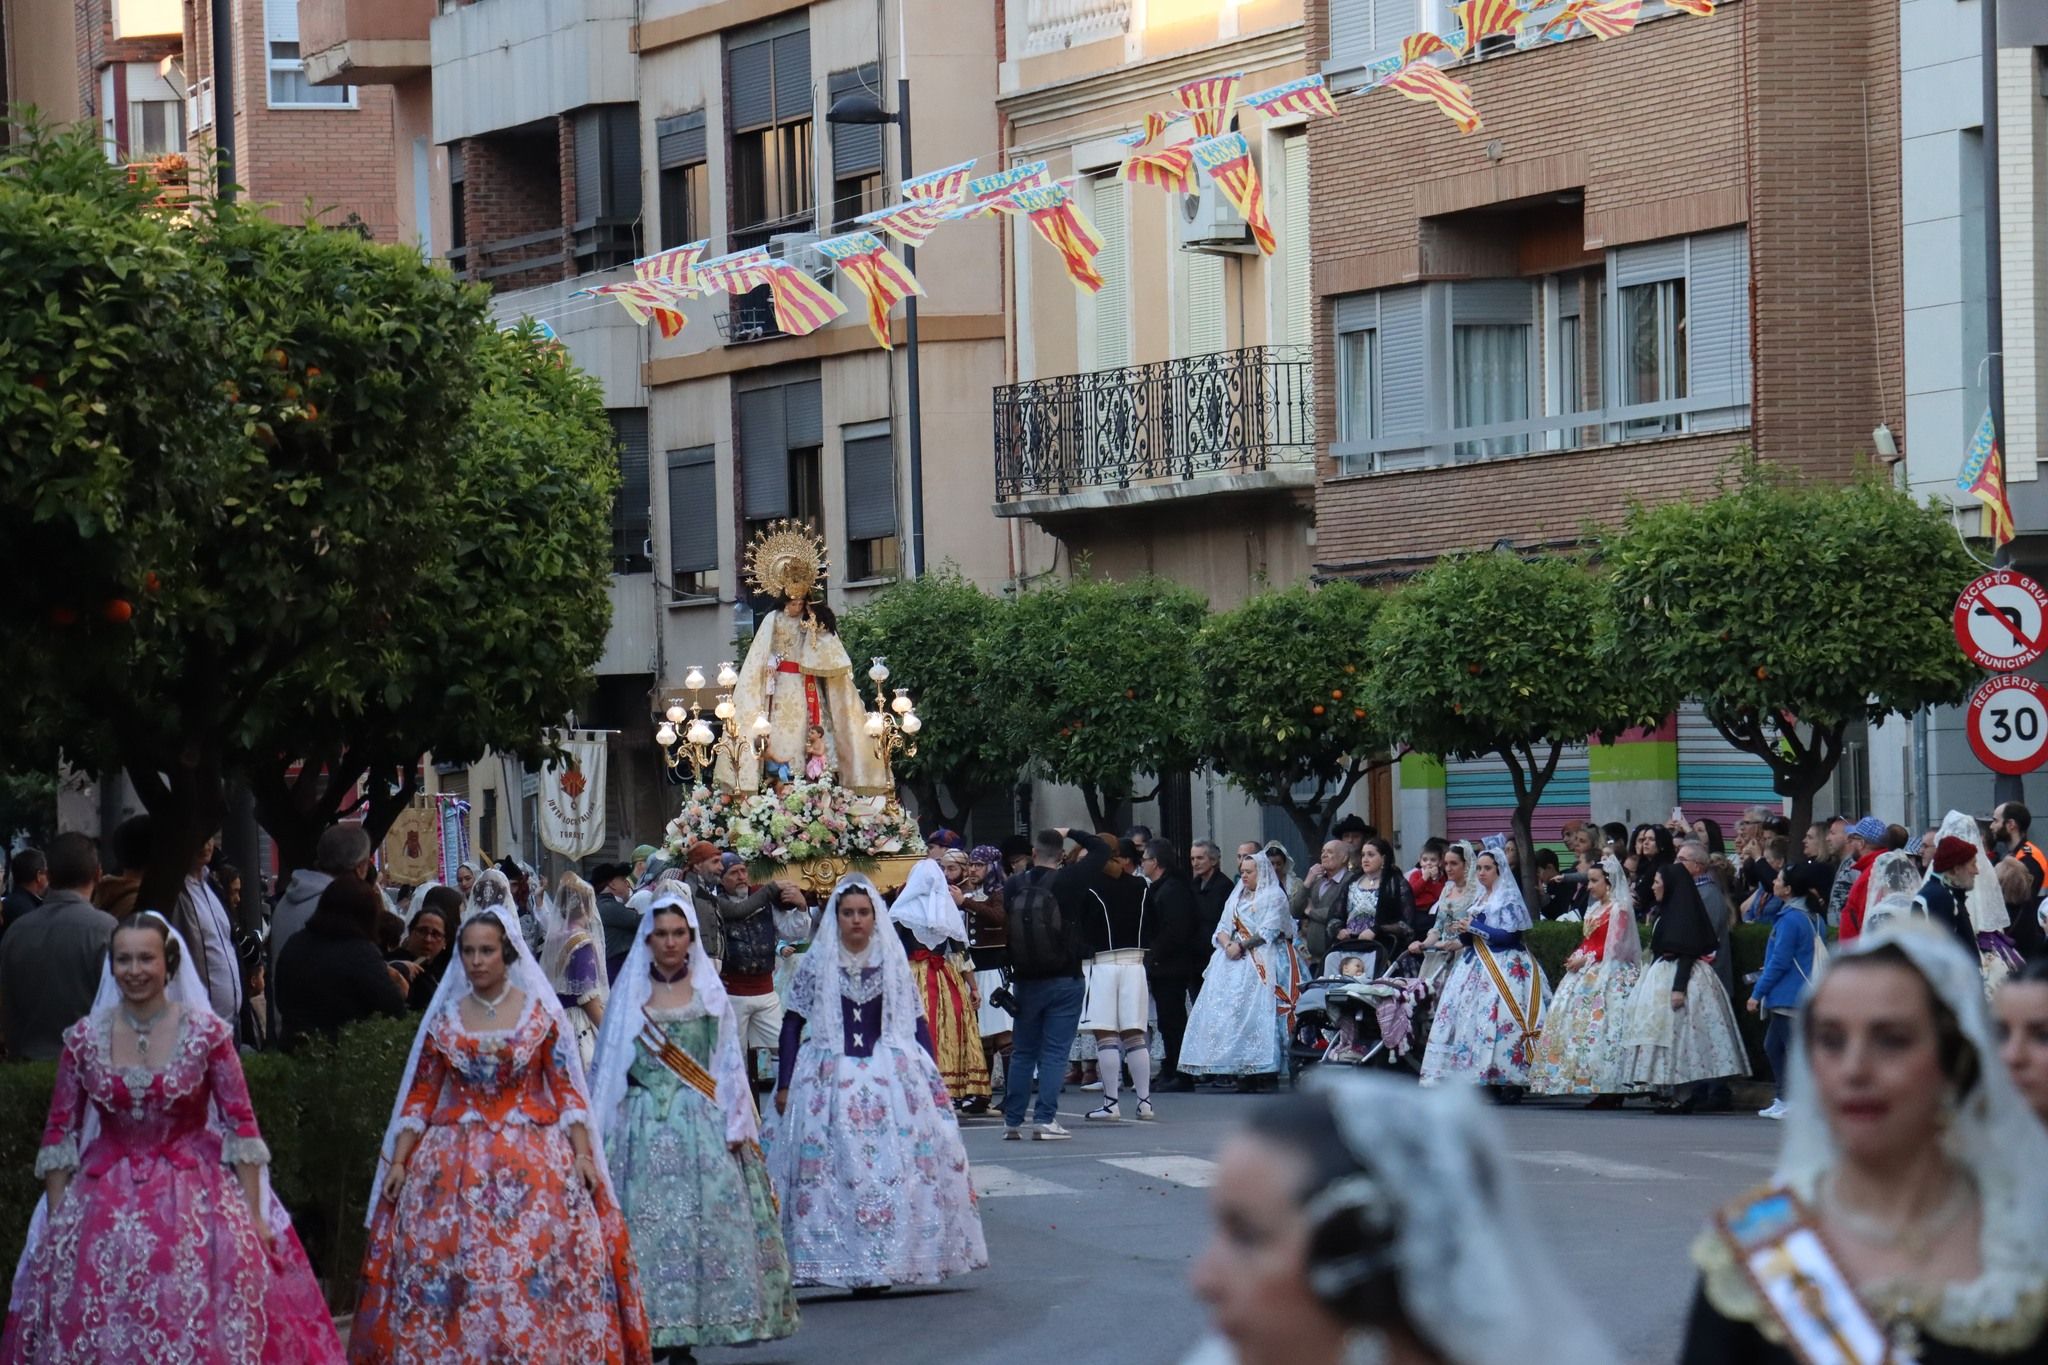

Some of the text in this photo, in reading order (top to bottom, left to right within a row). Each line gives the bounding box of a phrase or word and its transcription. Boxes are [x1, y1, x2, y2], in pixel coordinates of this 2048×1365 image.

[1959, 574, 2048, 611] EXCEPTO GRUA
[1975, 649, 2040, 668] MUNICIPAL
[1973, 676, 2040, 709] RECUERDE
[1990, 707, 2039, 743] 30
